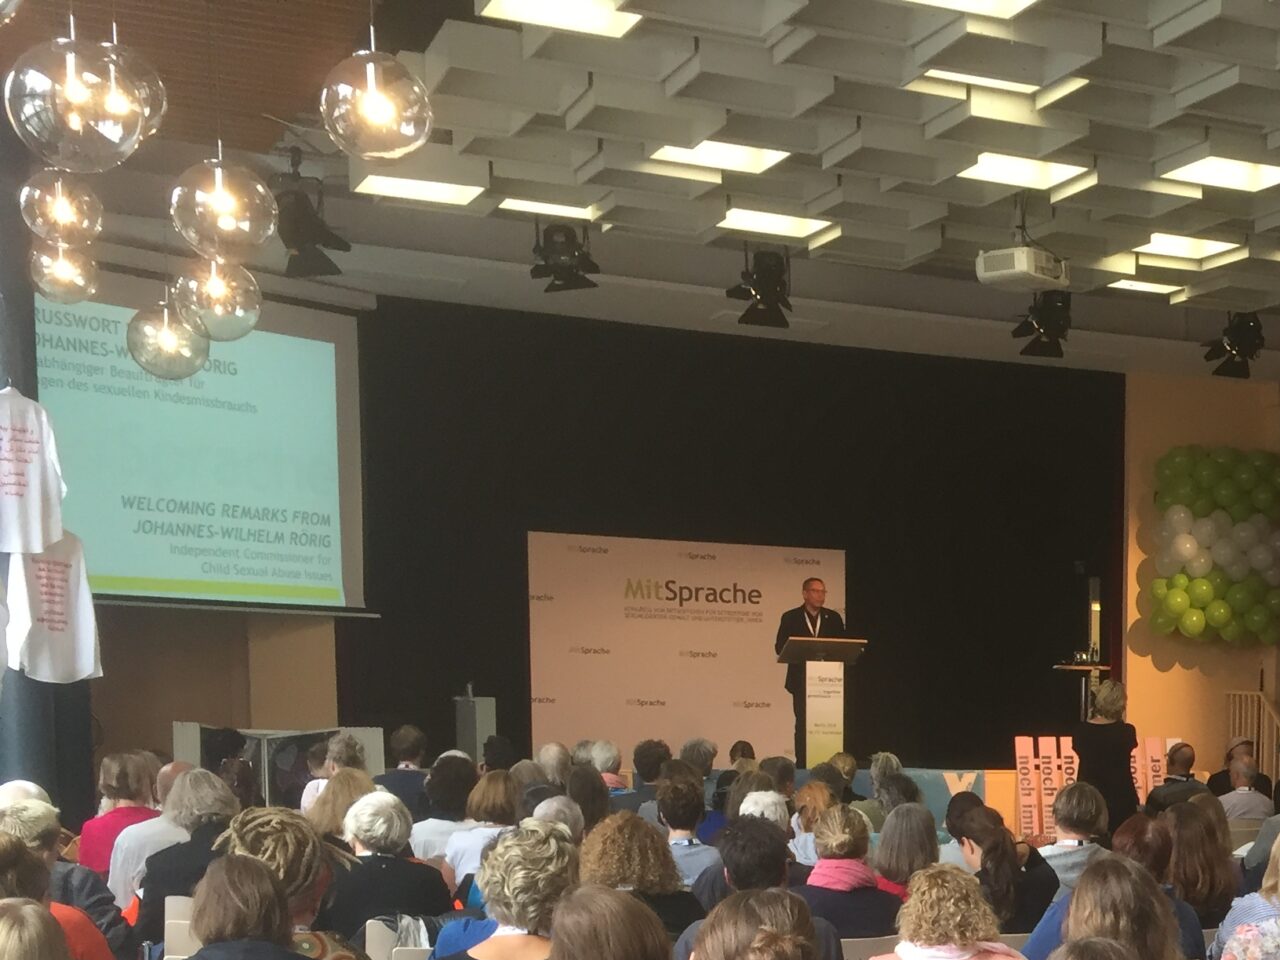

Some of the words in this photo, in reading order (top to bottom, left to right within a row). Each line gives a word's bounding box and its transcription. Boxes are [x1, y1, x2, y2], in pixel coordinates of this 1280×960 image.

[35, 307, 121, 336] RUSSWORT
[121, 495, 216, 517] WELCOMING
[221, 503, 288, 523] REMARKS
[292, 510, 331, 528] FROM
[133, 519, 285, 545] JOHANNES-WILHELM
[169, 543, 240, 561] Independent
[201, 561, 230, 576] Child
[624, 578, 762, 607] MitSprache
[1019, 755, 1035, 796] noch
[1042, 755, 1058, 796] noch
